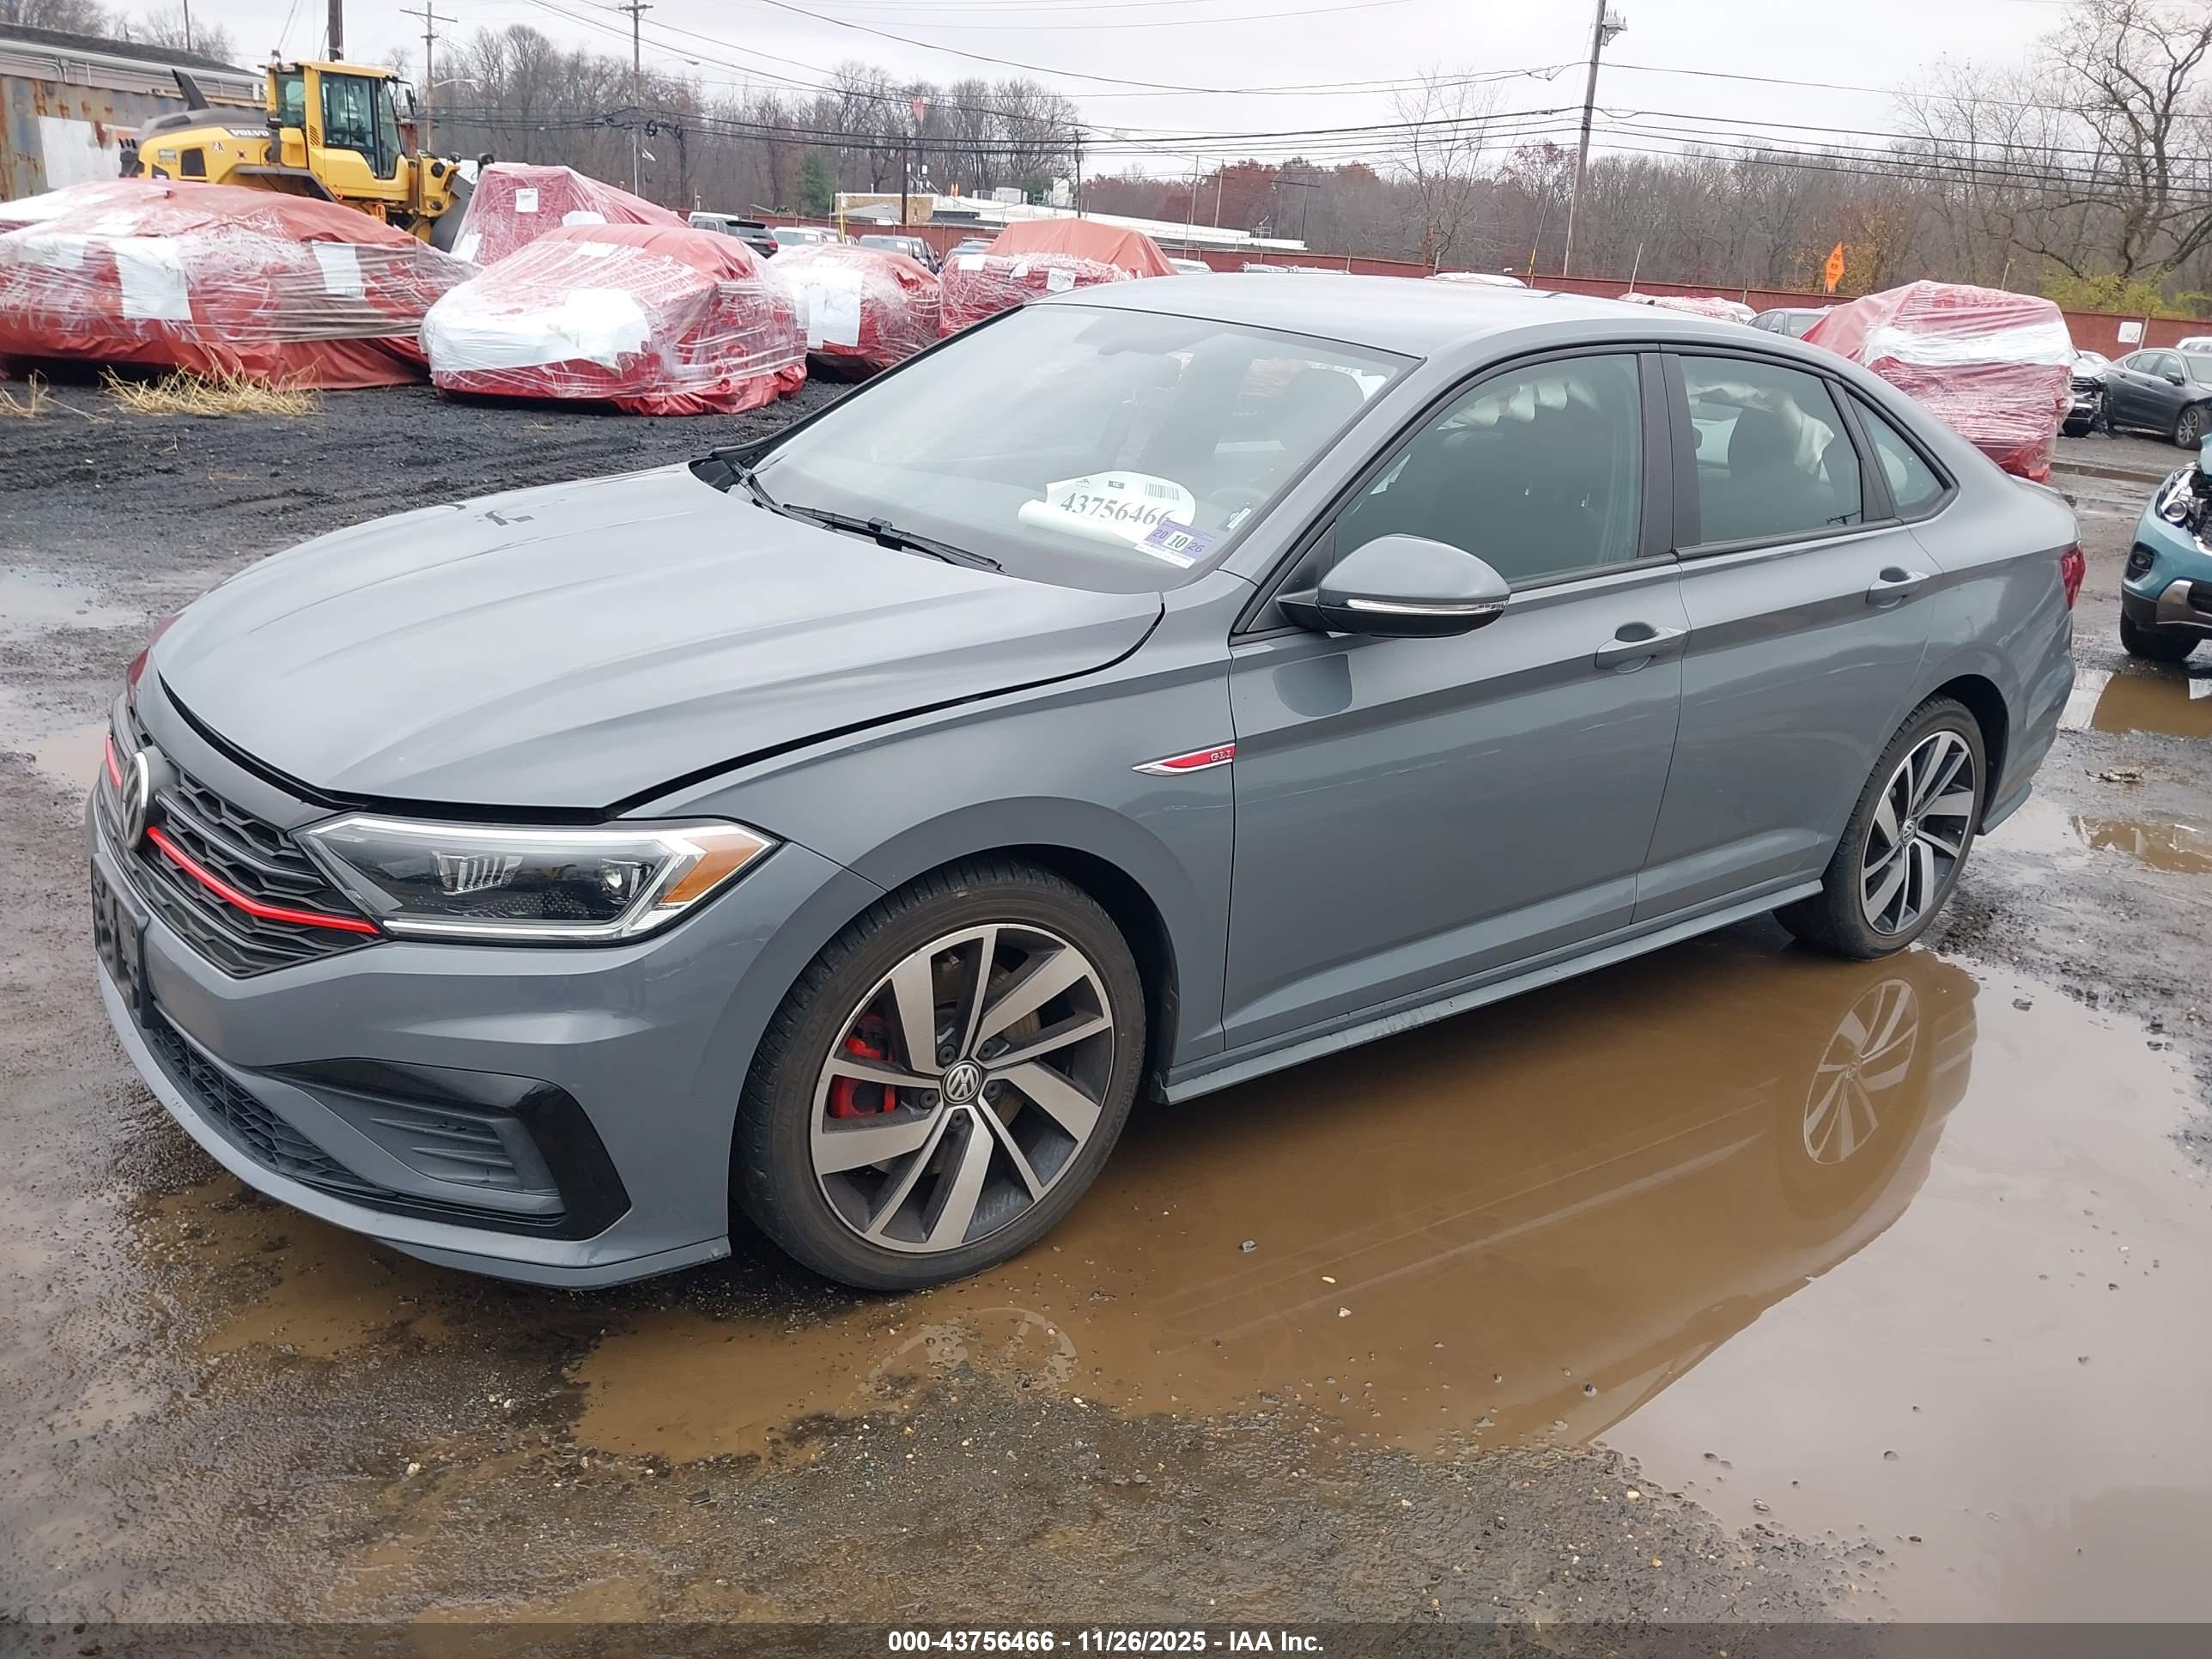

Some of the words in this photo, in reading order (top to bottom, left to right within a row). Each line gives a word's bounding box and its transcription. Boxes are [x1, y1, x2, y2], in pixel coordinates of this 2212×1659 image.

[1153, 529, 1169, 539] 20
[1168, 534, 1188, 549] 10
[1188, 542, 1205, 552] 26
